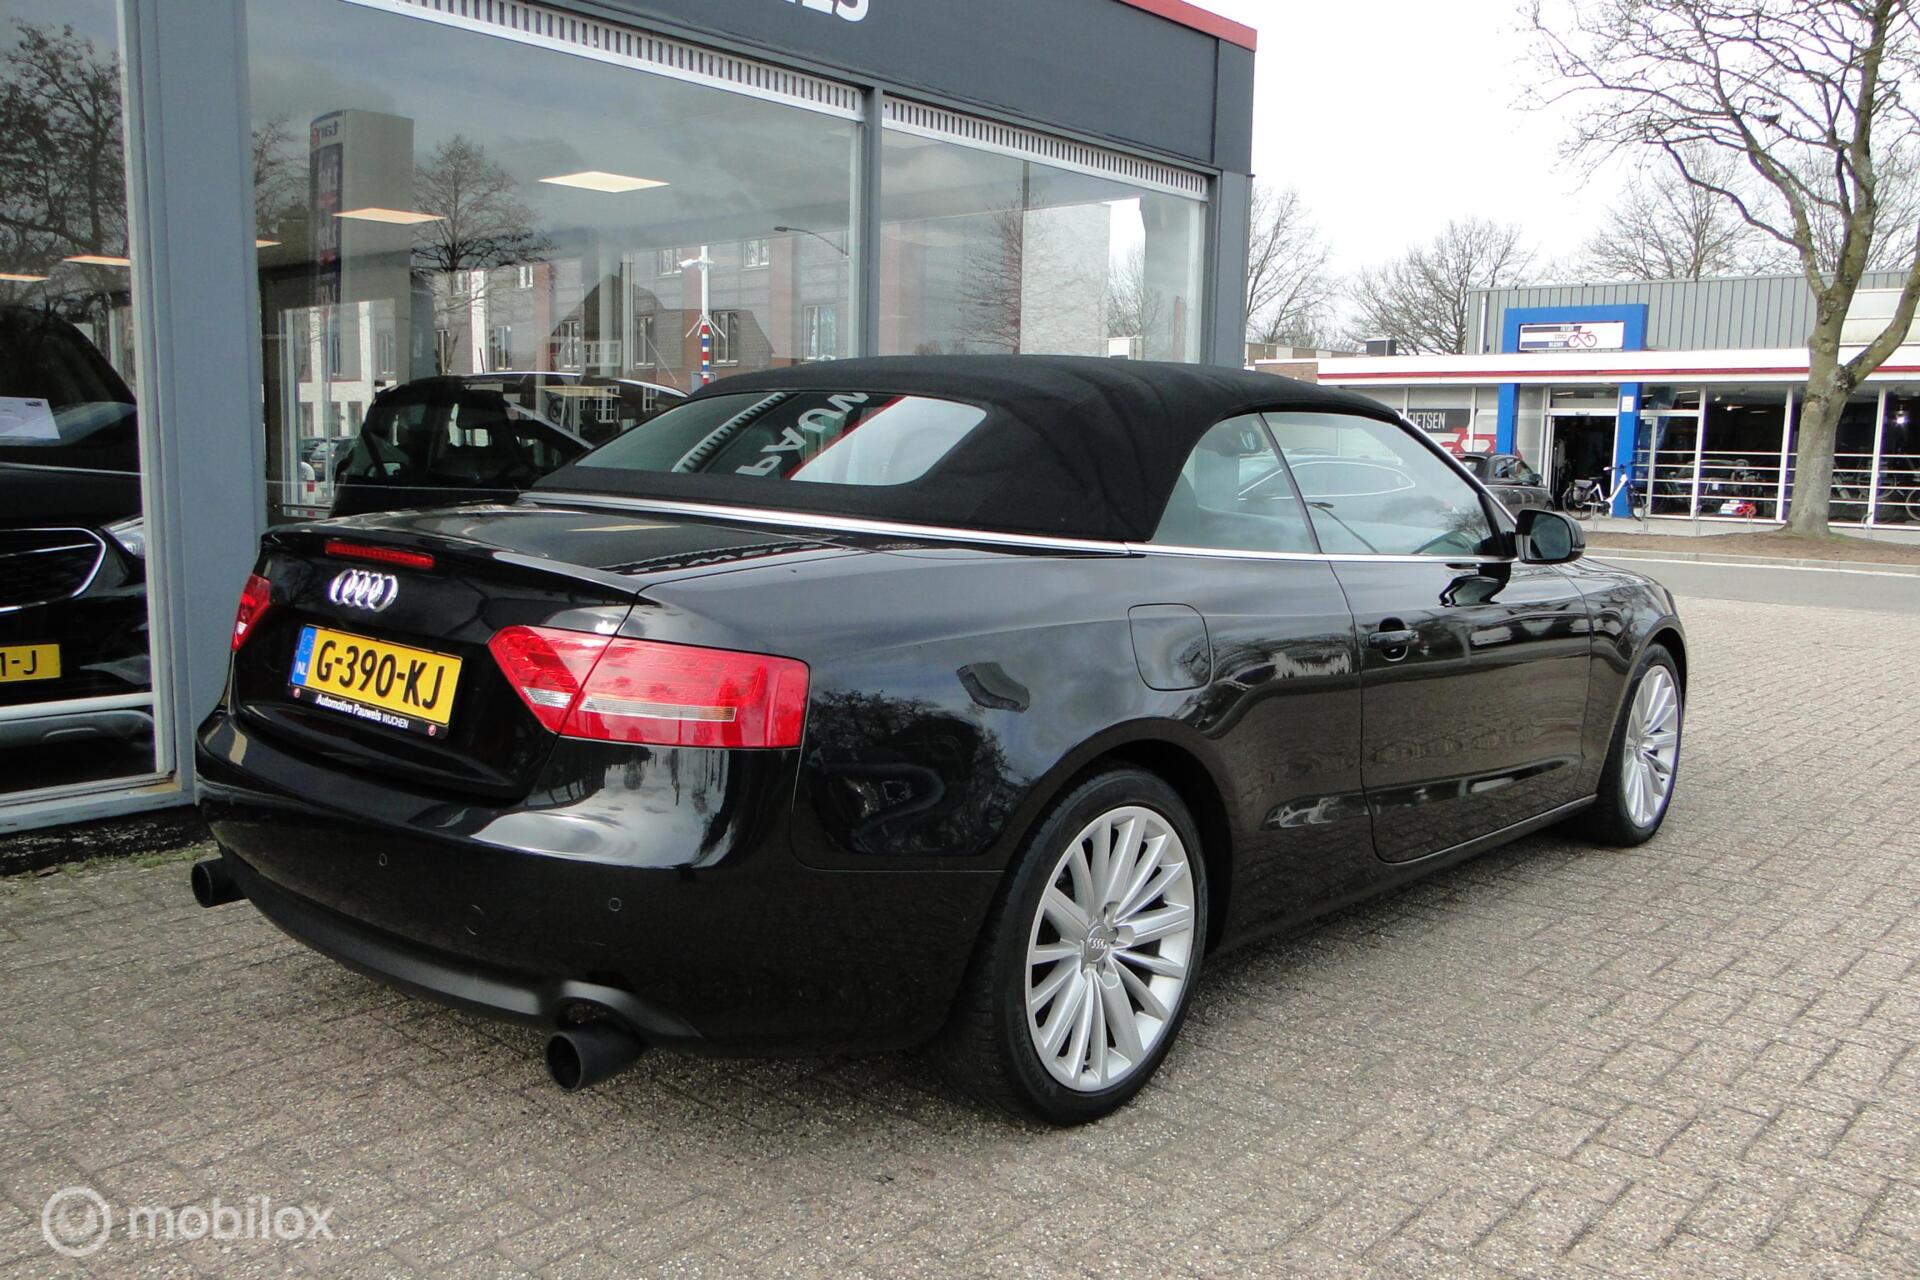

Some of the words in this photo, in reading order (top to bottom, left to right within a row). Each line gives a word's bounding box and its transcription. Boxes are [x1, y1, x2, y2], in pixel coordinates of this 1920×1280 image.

[296, 661, 307, 676] NL
[316, 639, 445, 710] G-390-KJ
[315, 694, 353, 713] Automotive
[353, 705, 382, 721] Pauwels
